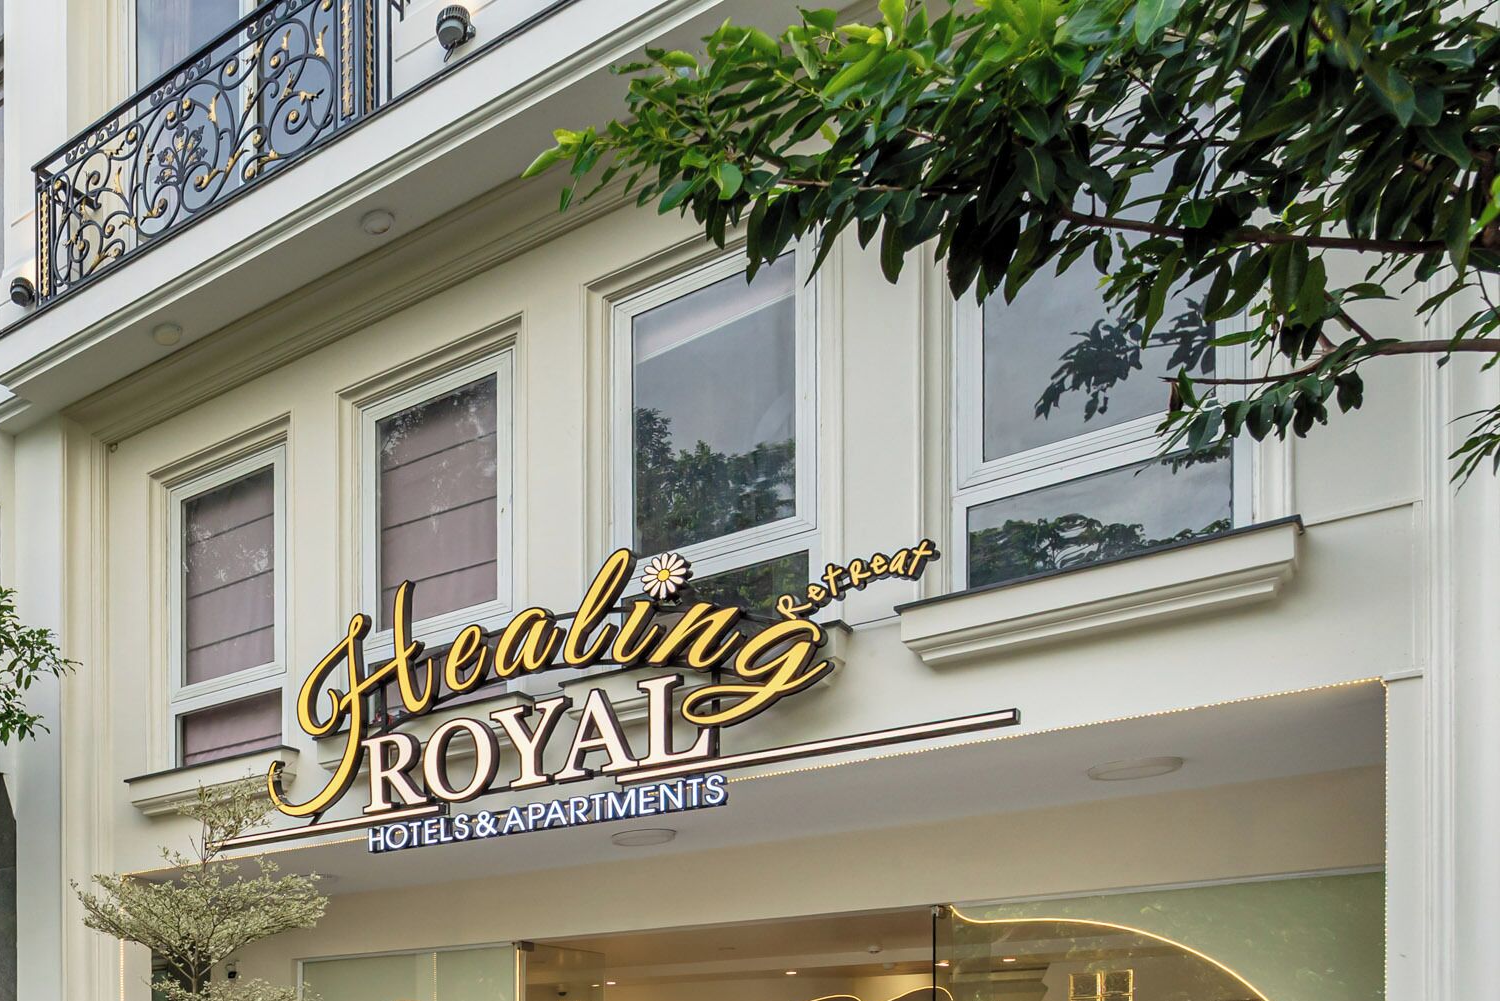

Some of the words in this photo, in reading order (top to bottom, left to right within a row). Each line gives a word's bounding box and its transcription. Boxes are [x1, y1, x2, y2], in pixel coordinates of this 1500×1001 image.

[776, 538, 941, 623] Retreat
[268, 547, 836, 818] Healing
[364, 674, 718, 815] ROYAL
[368, 815, 470, 853] HOTELS
[503, 774, 728, 835] APARTMENTS
